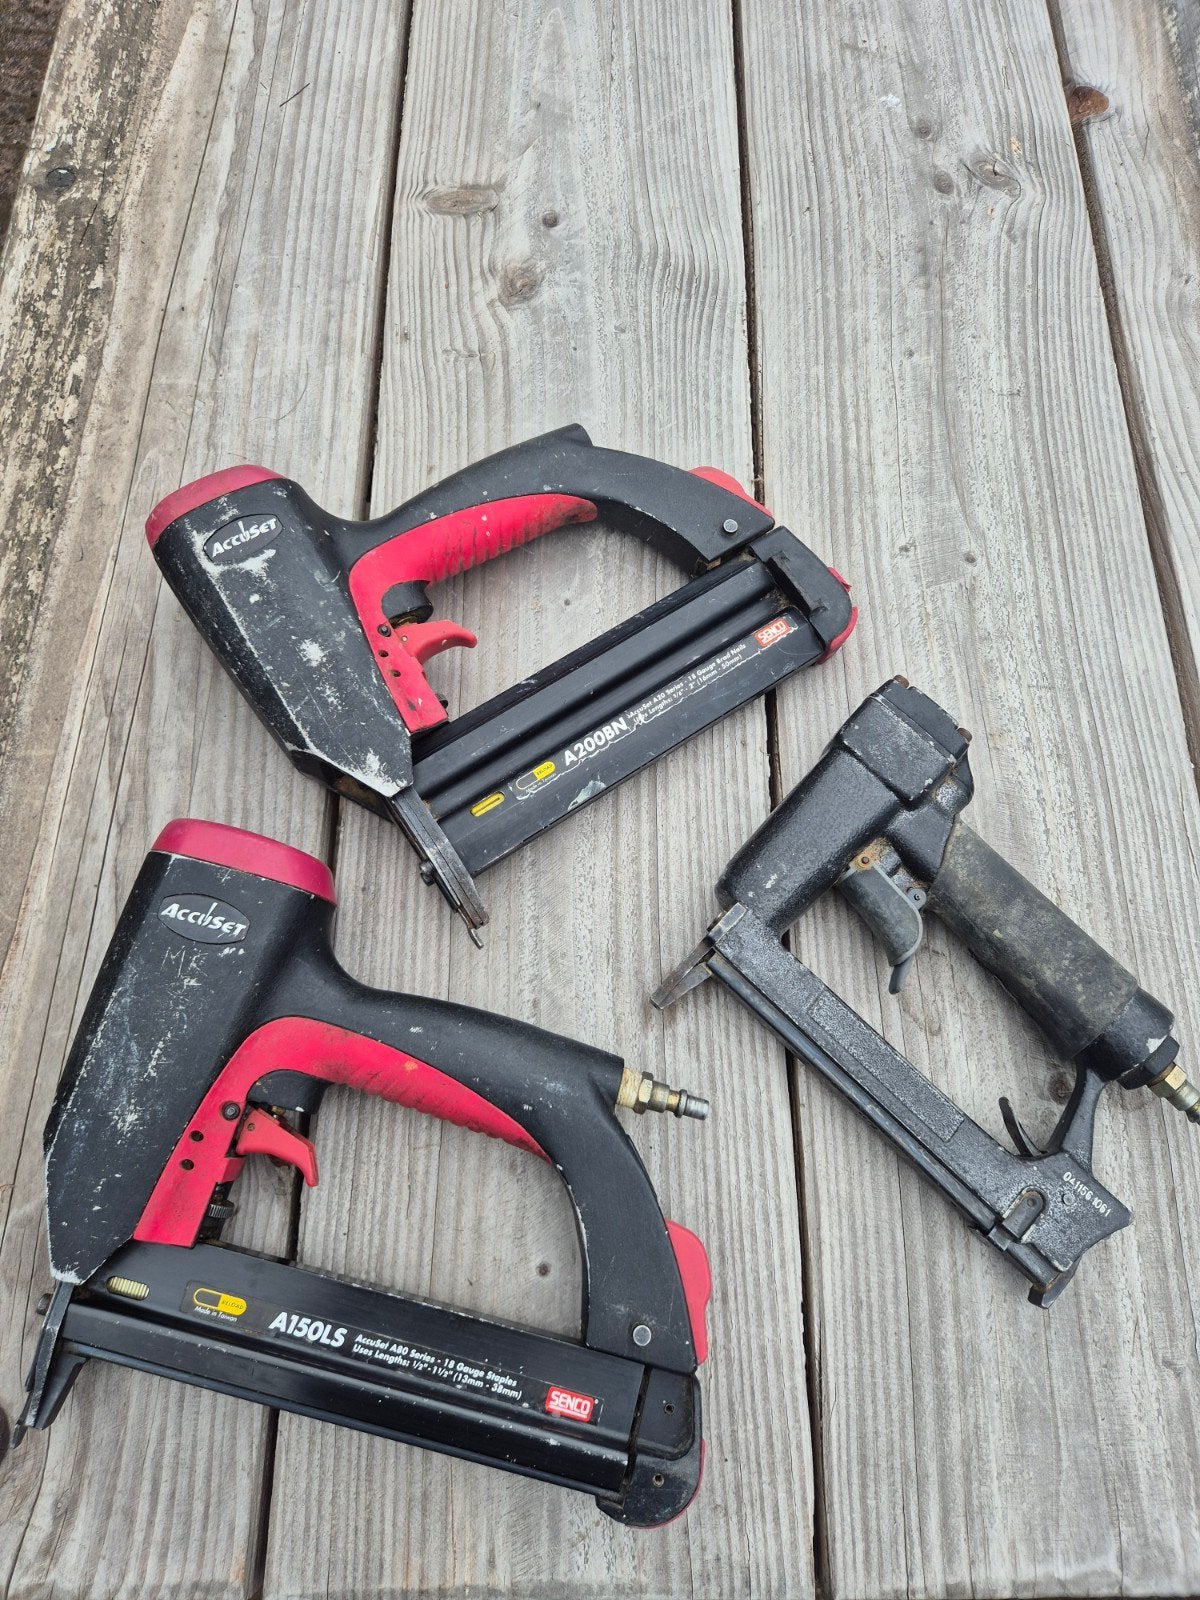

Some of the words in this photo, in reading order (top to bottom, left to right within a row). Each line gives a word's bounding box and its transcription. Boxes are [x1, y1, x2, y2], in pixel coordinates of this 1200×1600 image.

[758, 621, 786, 643] SENCO
[653, 691, 666, 704] A20
[665, 681, 684, 696] Series
[696, 661, 717, 677] Gauge
[715, 651, 732, 664] Brad
[730, 643, 747, 656] Nails
[721, 654, 744, 670] 50mm)
[564, 716, 629, 767] A200BN
[194, 1305, 211, 1315] Made
[218, 1311, 238, 1322] Taiwan
[268, 1311, 348, 1348] A150LS
[353, 1343, 373, 1357] Uses
[374, 1350, 410, 1368] Lengths:
[453, 1372, 484, 1388] (13mm
[491, 1383, 522, 1400] 38mm)
[355, 1334, 389, 1349] AccuSet
[389, 1343, 409, 1356] A80
[409, 1349, 435, 1364] Series
[443, 1358, 455, 1369] 18
[456, 1362, 485, 1378] Gauge
[486, 1371, 518, 1387] Staples
[550, 1390, 591, 1415] SENCO
